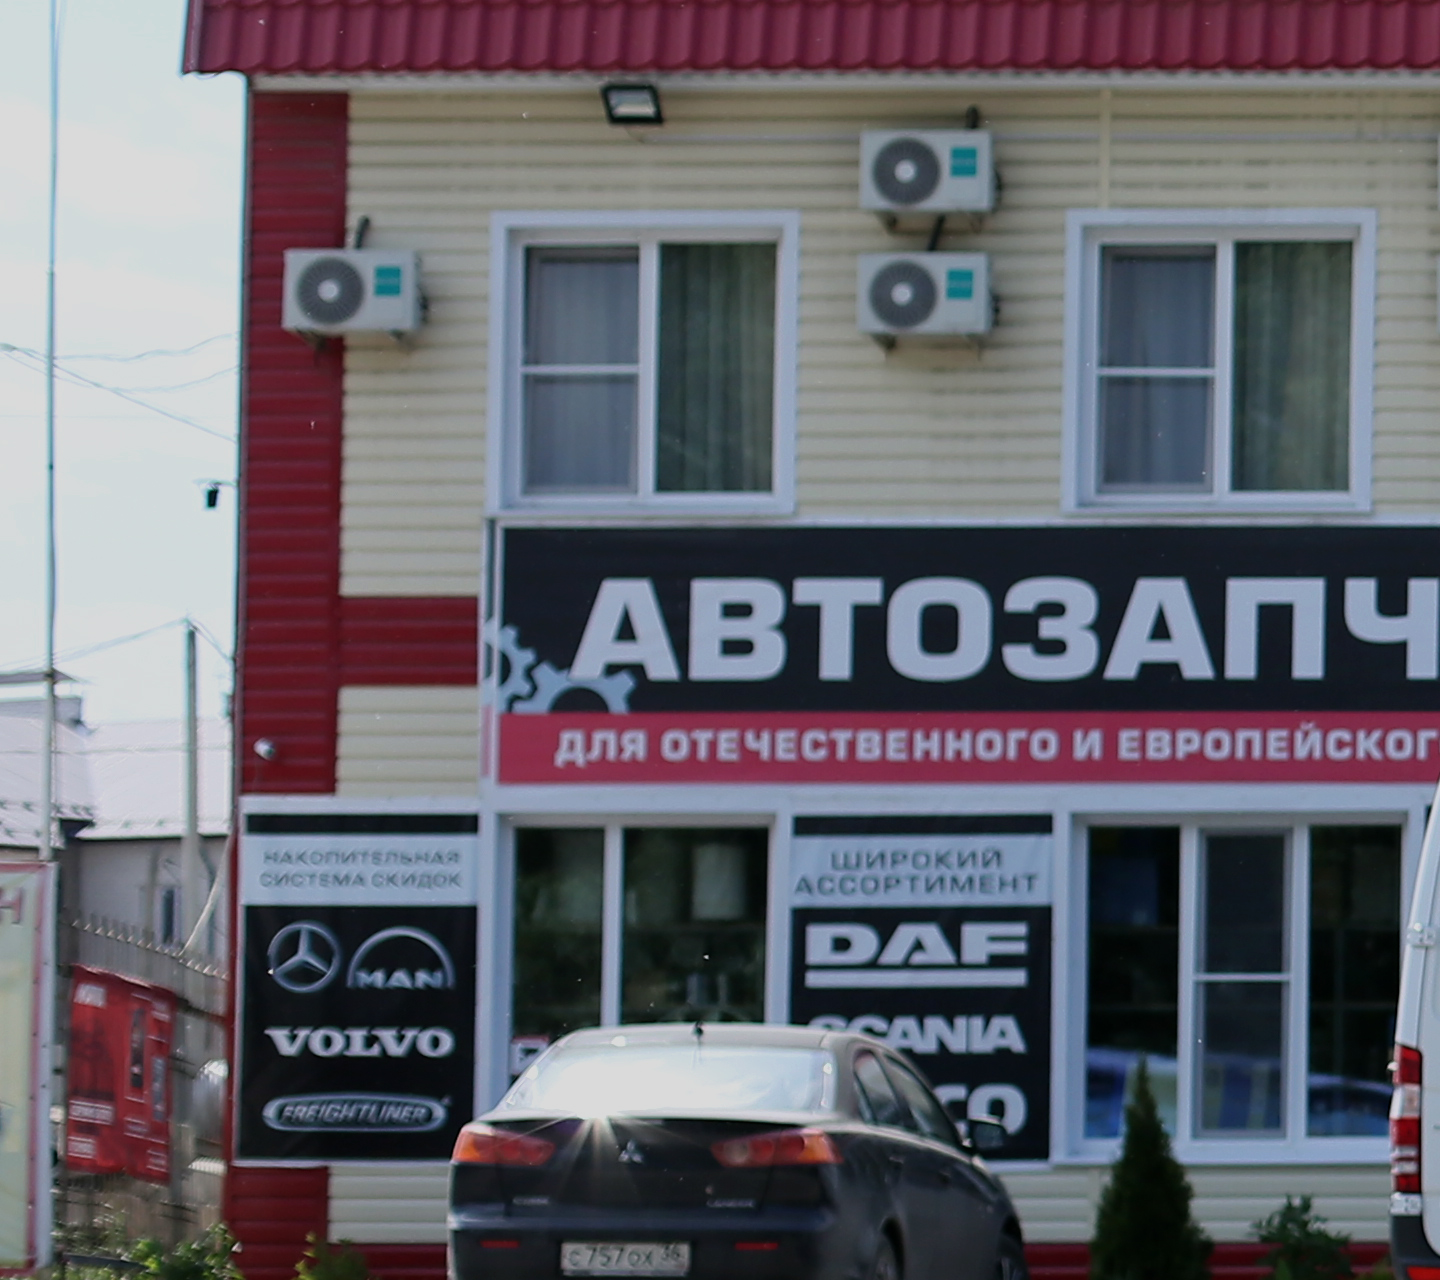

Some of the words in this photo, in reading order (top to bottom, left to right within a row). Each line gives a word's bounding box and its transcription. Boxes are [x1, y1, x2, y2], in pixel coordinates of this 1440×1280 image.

[553, 727, 648, 769] ДЛЯ
[659, 728, 1059, 763] ОТЕЧЕСТВЕННОГО
[1072, 728, 1104, 762] И
[263, 848, 462, 865] НАКОПИТЕЛЬНАЯ
[830, 846, 1002, 871] ШИРОКИЙ
[259, 872, 366, 889] СИСТЕМА
[370, 872, 462, 890] СКИДОК
[794, 873, 1039, 896] АССОРТИМЕНТ
[804, 921, 1028, 966] DAF
[356, 968, 444, 990] MAN
[263, 1026, 456, 1058] VOLVO
[281, 1102, 429, 1123] FREIGHTLINER
